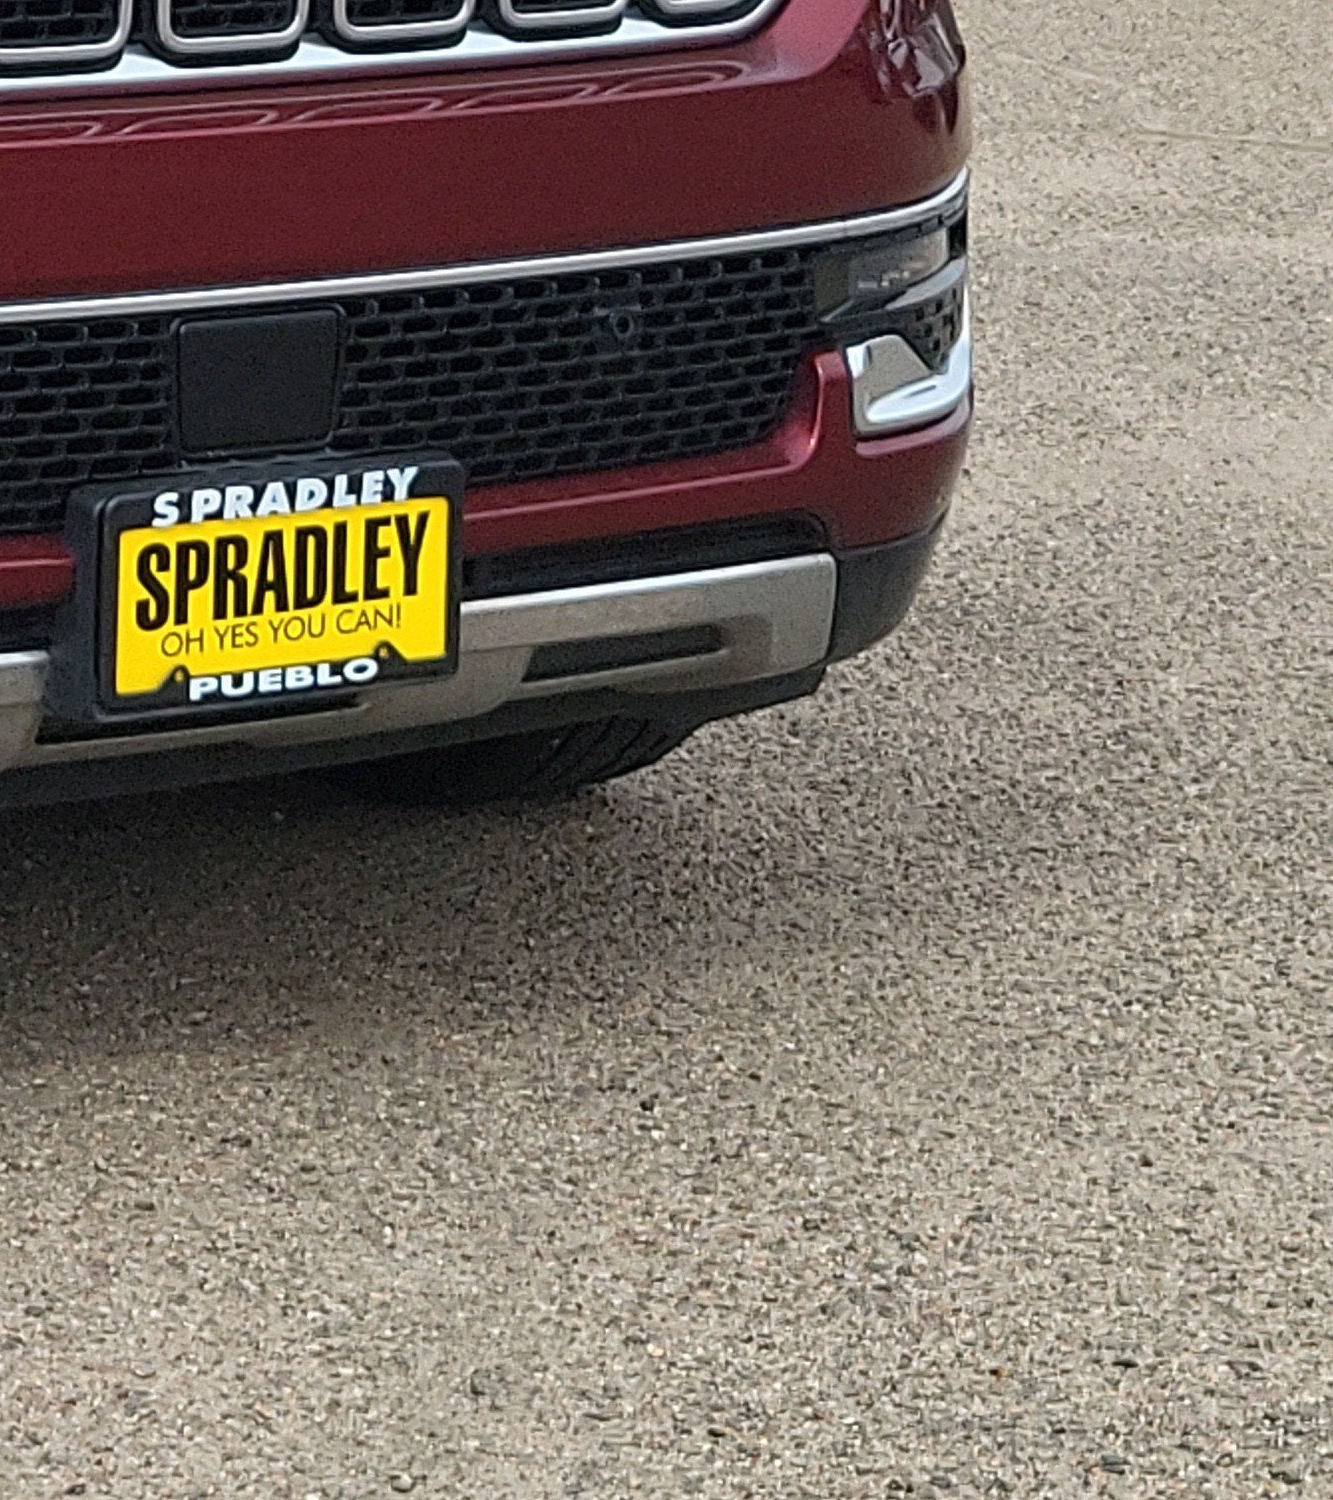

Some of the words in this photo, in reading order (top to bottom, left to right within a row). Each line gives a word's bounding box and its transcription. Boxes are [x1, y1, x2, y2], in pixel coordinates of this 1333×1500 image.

[152, 466, 419, 527] SPRADLEY
[135, 511, 431, 631] SPRADLEY
[161, 627, 204, 657] OH
[216, 623, 259, 650] YES
[270, 614, 326, 642] YOU
[336, 604, 402, 634] CAN!
[189, 658, 379, 701] PUEBLO
